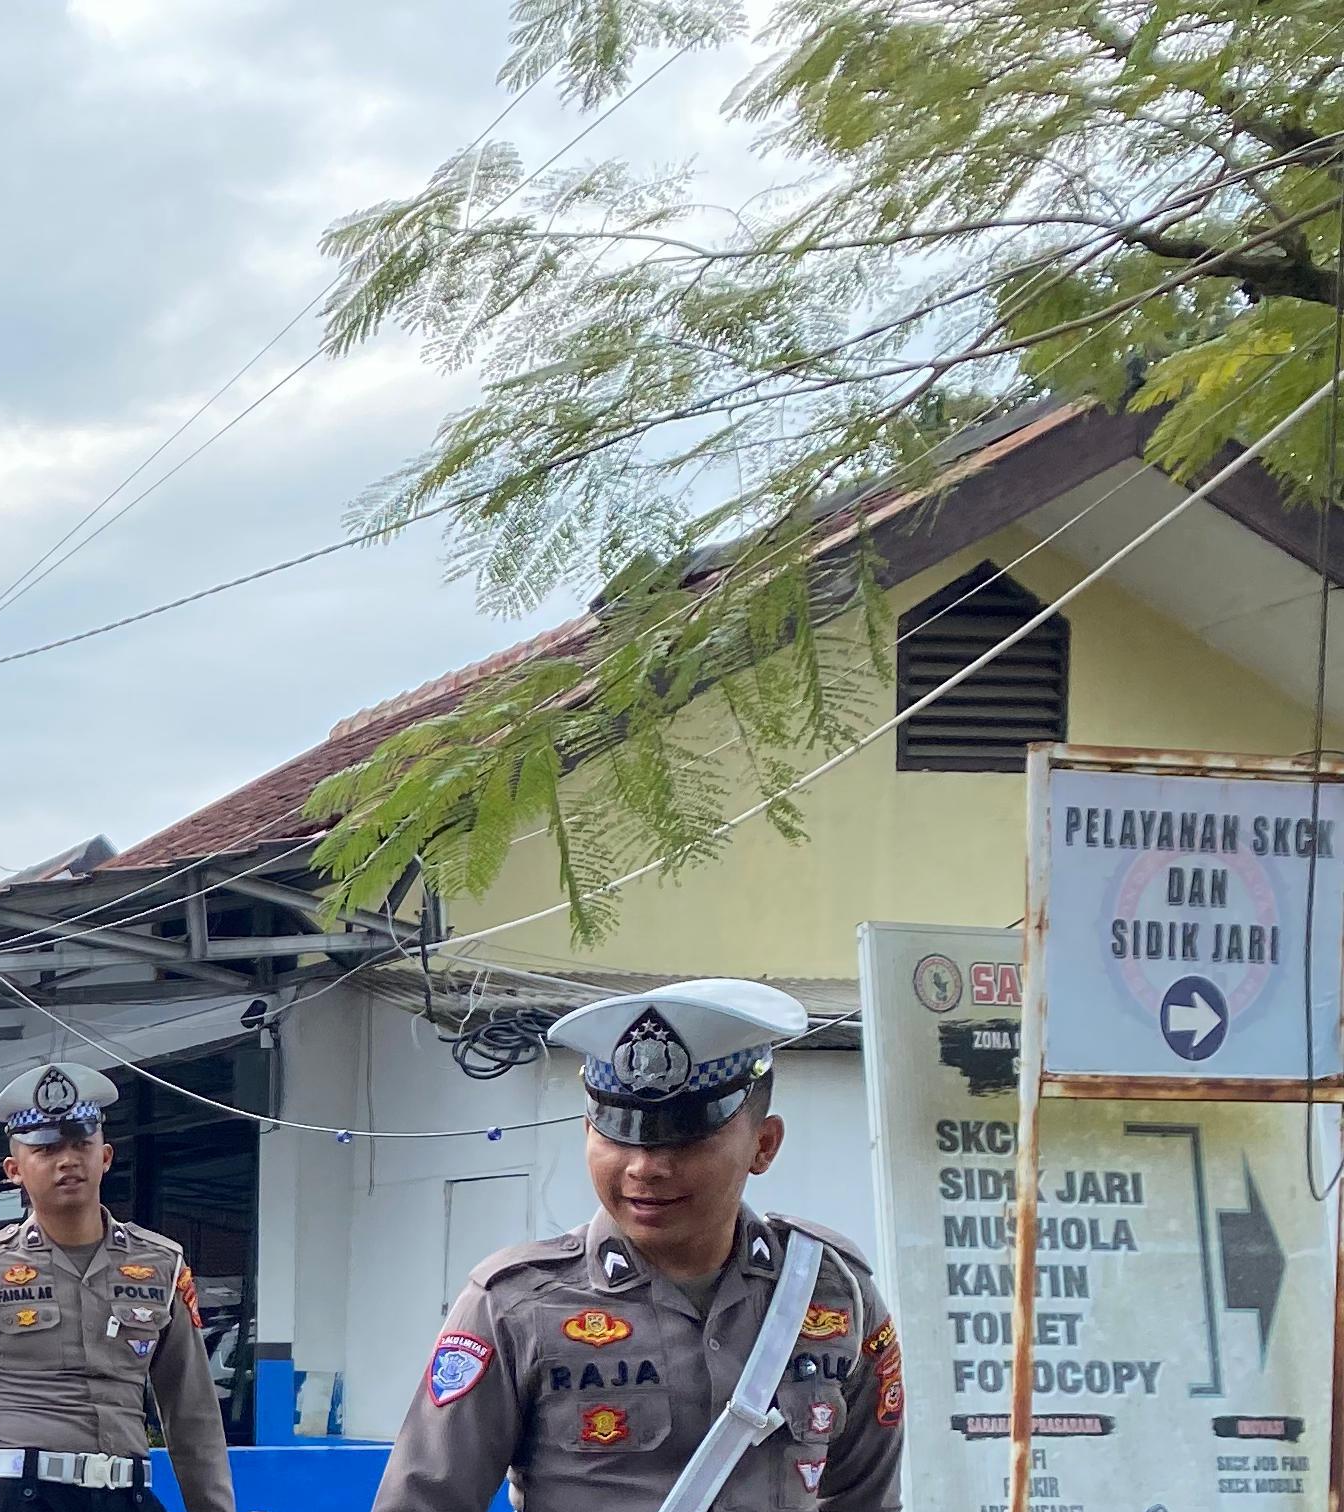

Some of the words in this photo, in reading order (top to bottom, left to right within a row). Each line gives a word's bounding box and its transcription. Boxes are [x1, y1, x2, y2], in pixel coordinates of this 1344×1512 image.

[1065, 806, 1240, 854] PELAYANAN
[1252, 815, 1336, 858] SKCK
[1168, 866, 1228, 908] DAN
[1112, 918, 1200, 961] SIDIK
[1212, 924, 1280, 964] JARI
[973, 1031, 1011, 1049] ZONA
[936, 1119, 1019, 1154] SKC
[1056, 1171, 1145, 1204] JARI
[114, 1286, 164, 1300] POLRI
[948, 1311, 1083, 1346] TOIET
[551, 1360, 660, 1390] RAJA
